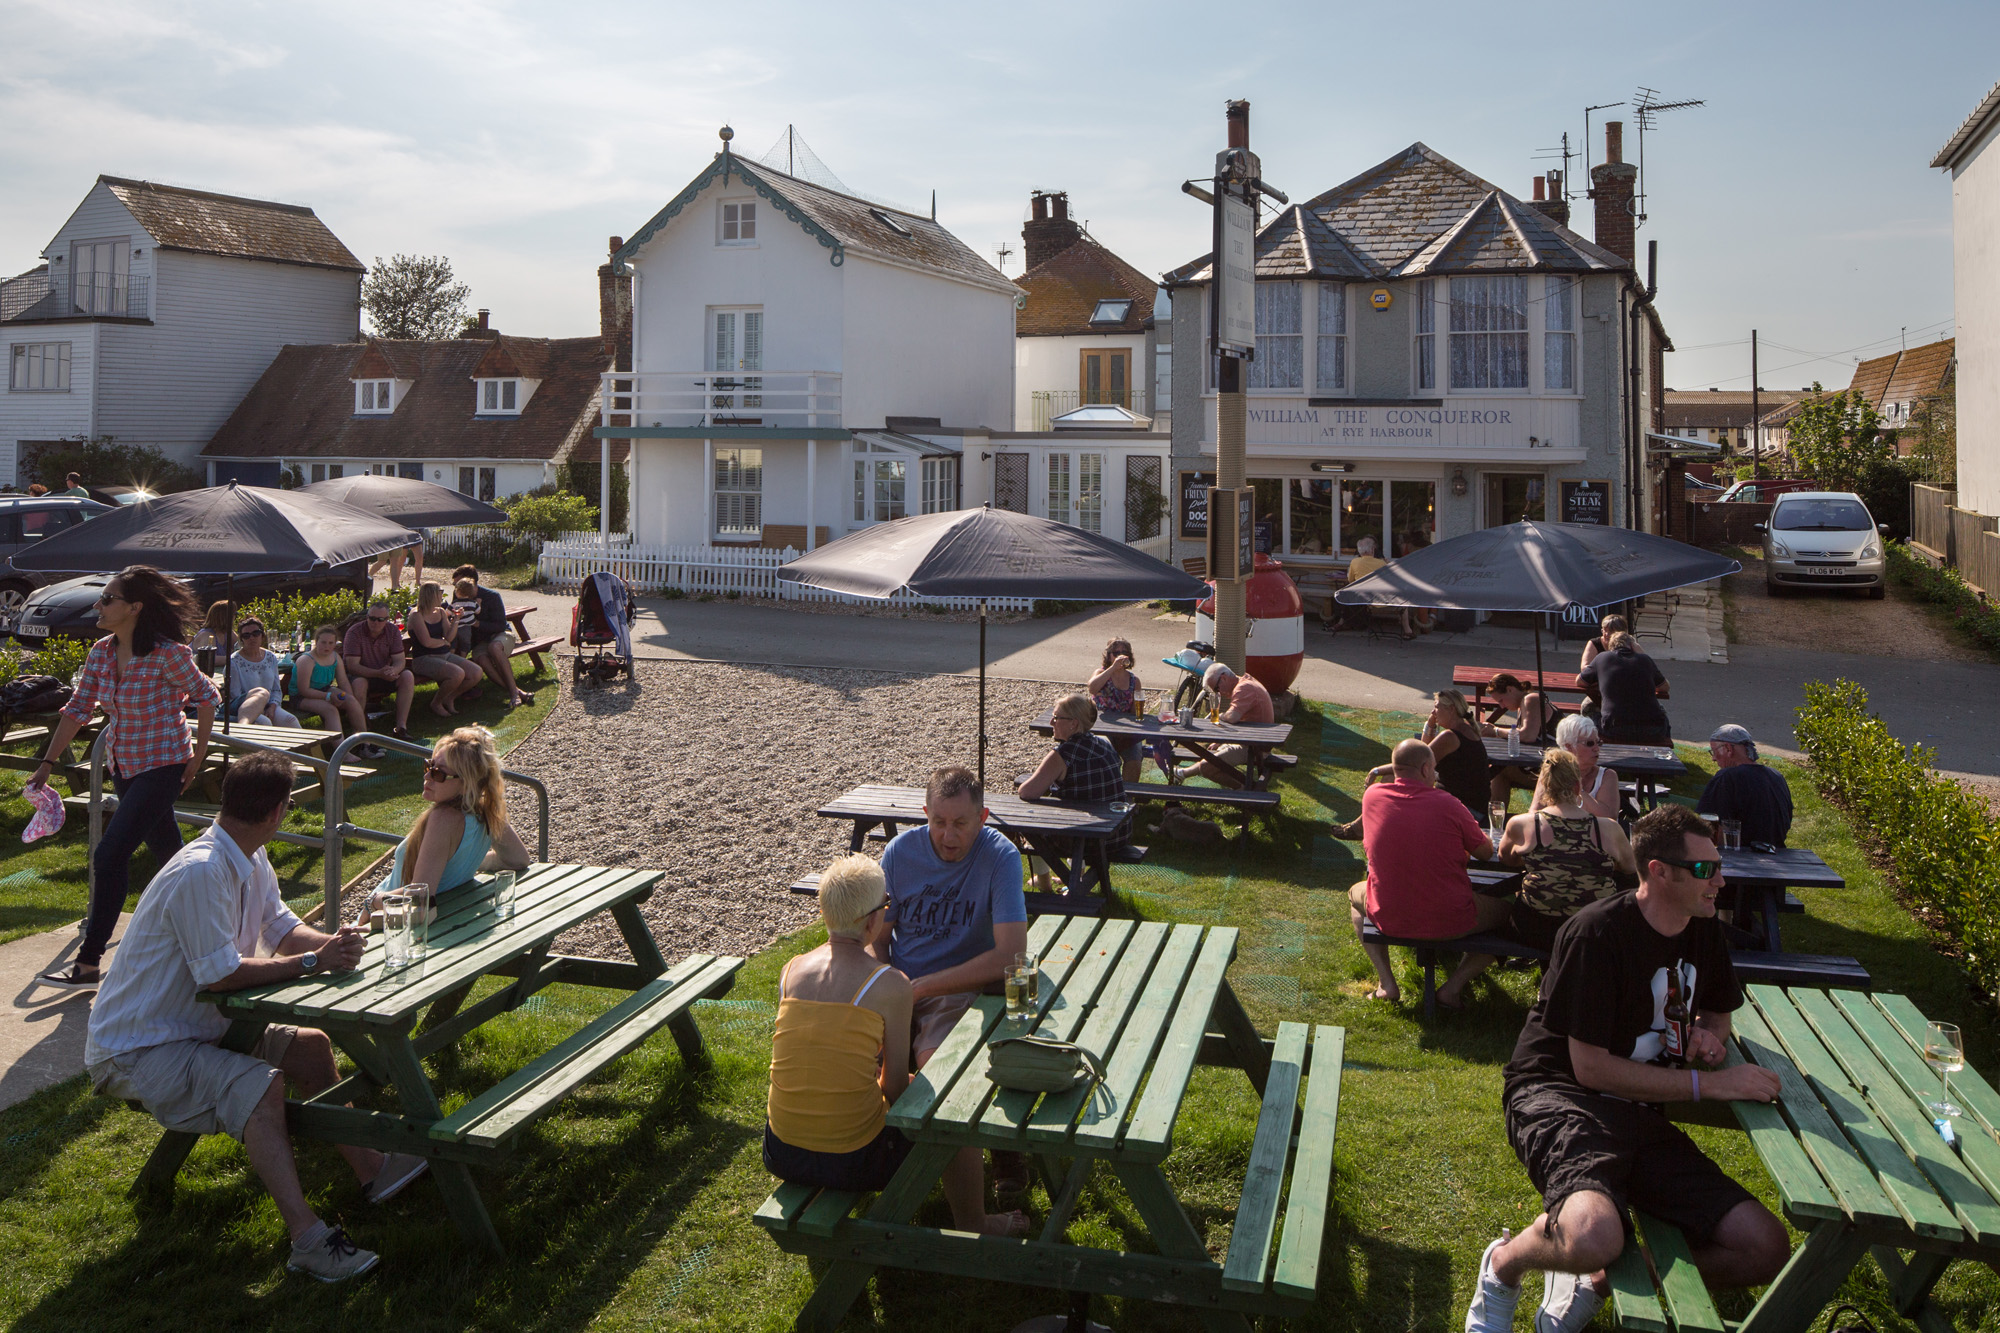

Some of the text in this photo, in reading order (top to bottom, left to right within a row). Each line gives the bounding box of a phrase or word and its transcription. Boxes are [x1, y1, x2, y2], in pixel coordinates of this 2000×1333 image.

[1226, 209, 1252, 232] WILLIAM
[1233, 239, 1244, 256] THE
[1248, 409, 1512, 425] WILLIAM THE CONQUEROR
[1320, 427, 1433, 438] AT RYE HARBOUR
[1572, 487, 1603, 498] Saturday
[1569, 496, 1601, 506] STEAK
[1572, 514, 1599, 524] Sunday
[1562, 606, 1599, 624] OPEN
[921, 883, 939, 897] New
[914, 924, 951, 939] RIVER
